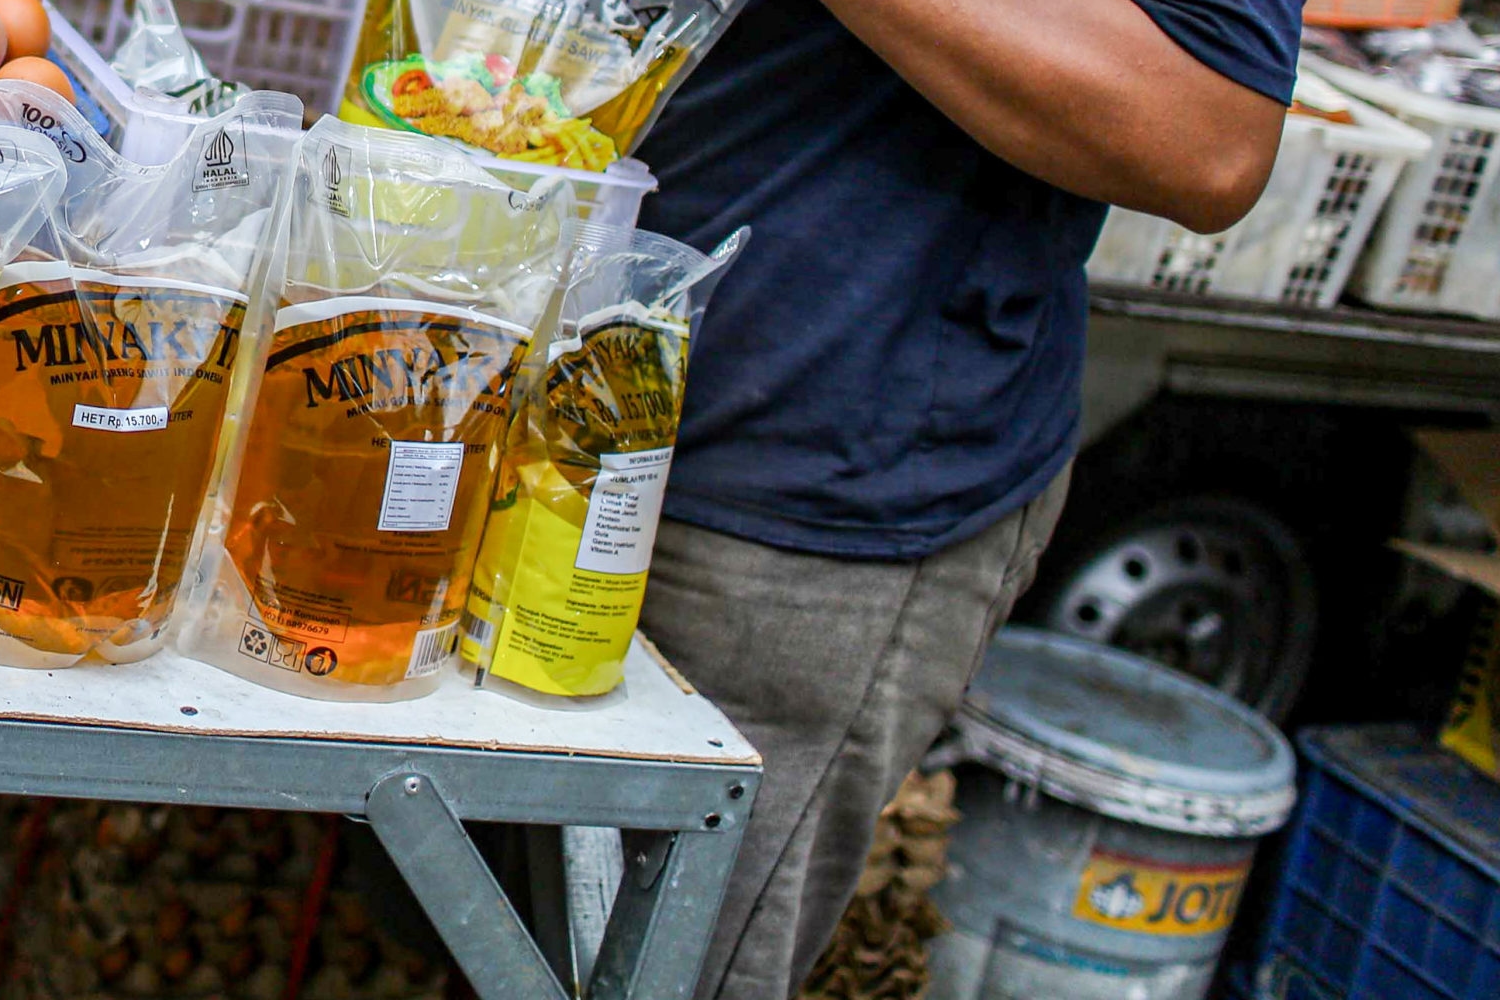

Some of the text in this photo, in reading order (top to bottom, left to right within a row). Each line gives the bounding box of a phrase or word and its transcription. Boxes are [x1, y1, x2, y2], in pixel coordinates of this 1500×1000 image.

[203, 166, 237, 178] HALAL
[81, 411, 164, 429] HET Rp. 15.700,-
